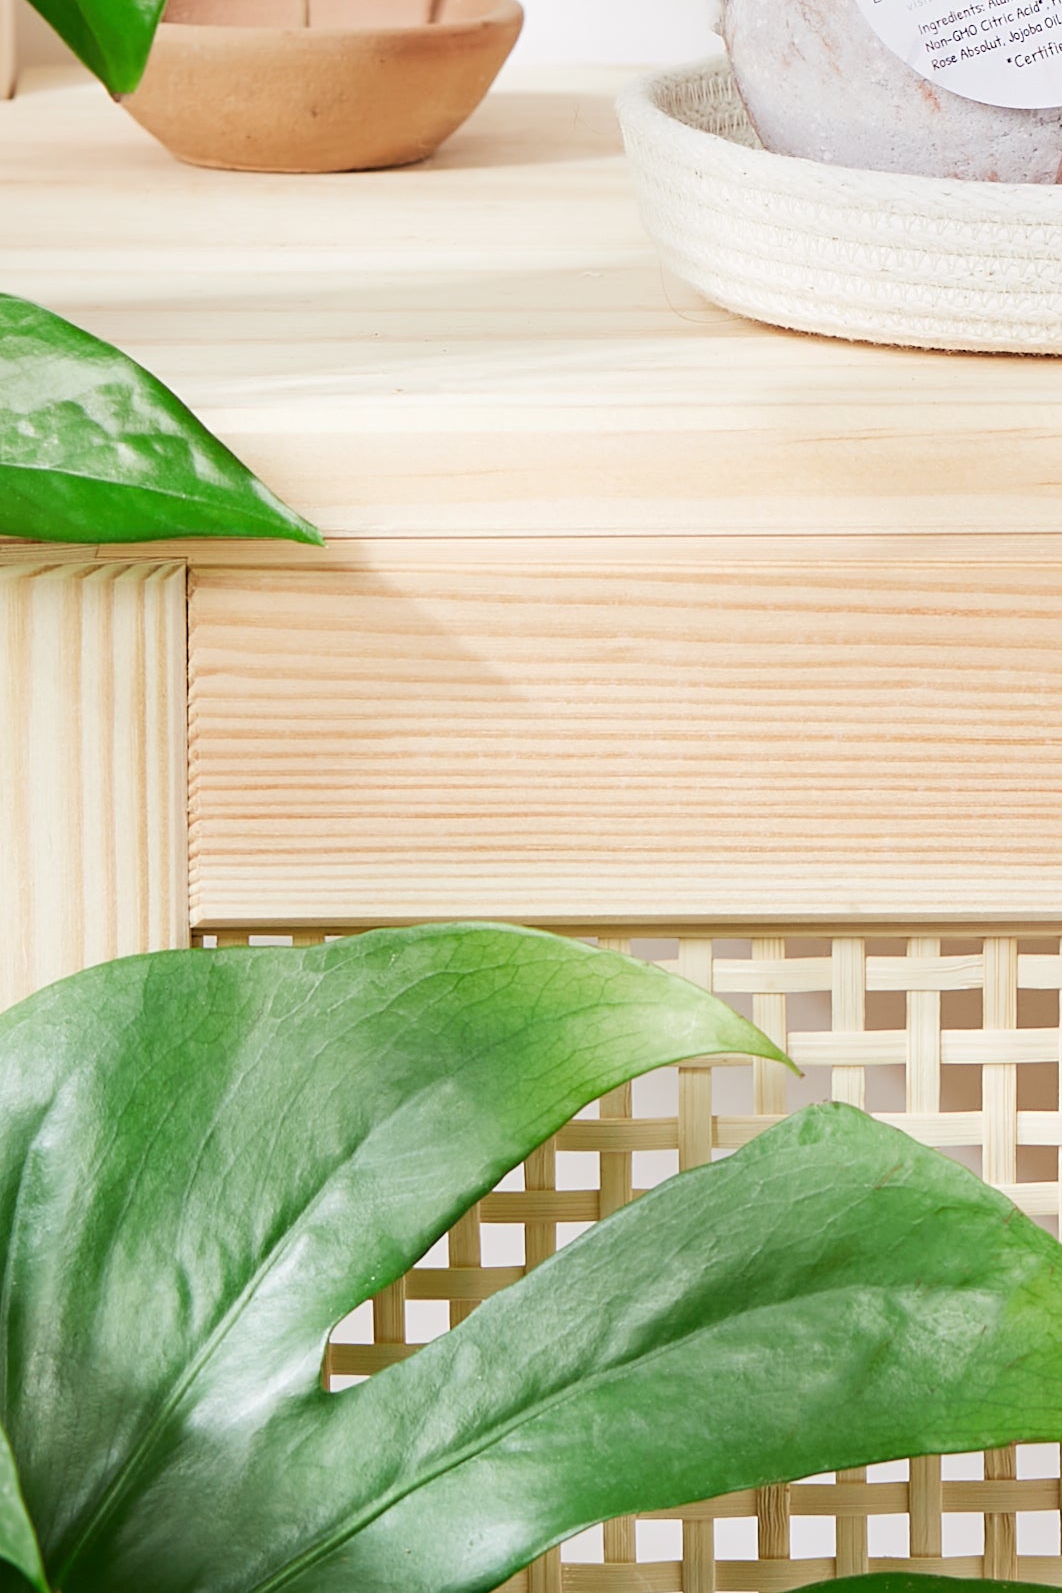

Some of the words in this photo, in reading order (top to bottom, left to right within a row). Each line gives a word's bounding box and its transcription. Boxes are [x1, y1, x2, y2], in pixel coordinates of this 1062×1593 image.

[918, 4, 986, 35] Ingredients:
[925, 24, 978, 52] Non-GMO
[980, 13, 1015, 31] Citric
[931, 54, 958, 71] Rose
[1008, 23, 1043, 43] Jojoba
[1044, 13, 1062, 29] Oil
